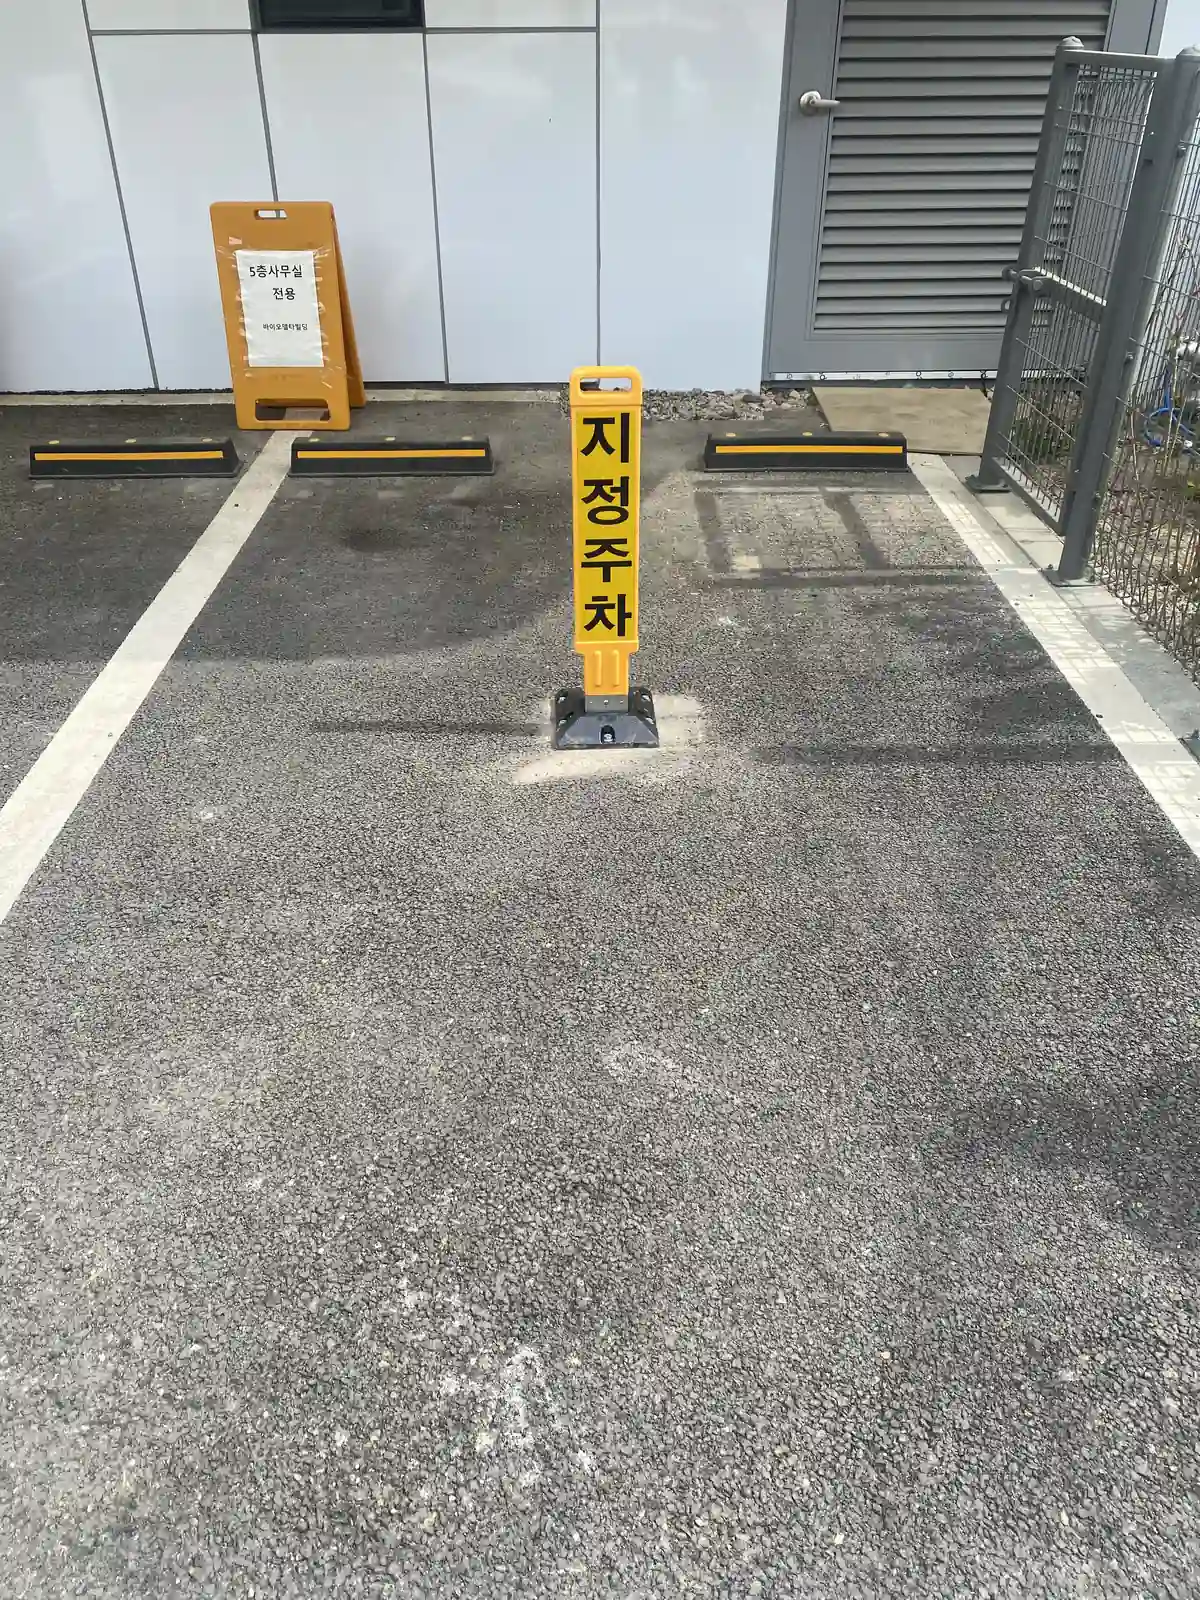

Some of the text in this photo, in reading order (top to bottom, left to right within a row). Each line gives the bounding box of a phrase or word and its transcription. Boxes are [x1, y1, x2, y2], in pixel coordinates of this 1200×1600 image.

[249, 264, 302, 278] 5층사무실
[272, 287, 296, 300] 전용
[580, 412, 633, 637] 지정주차
